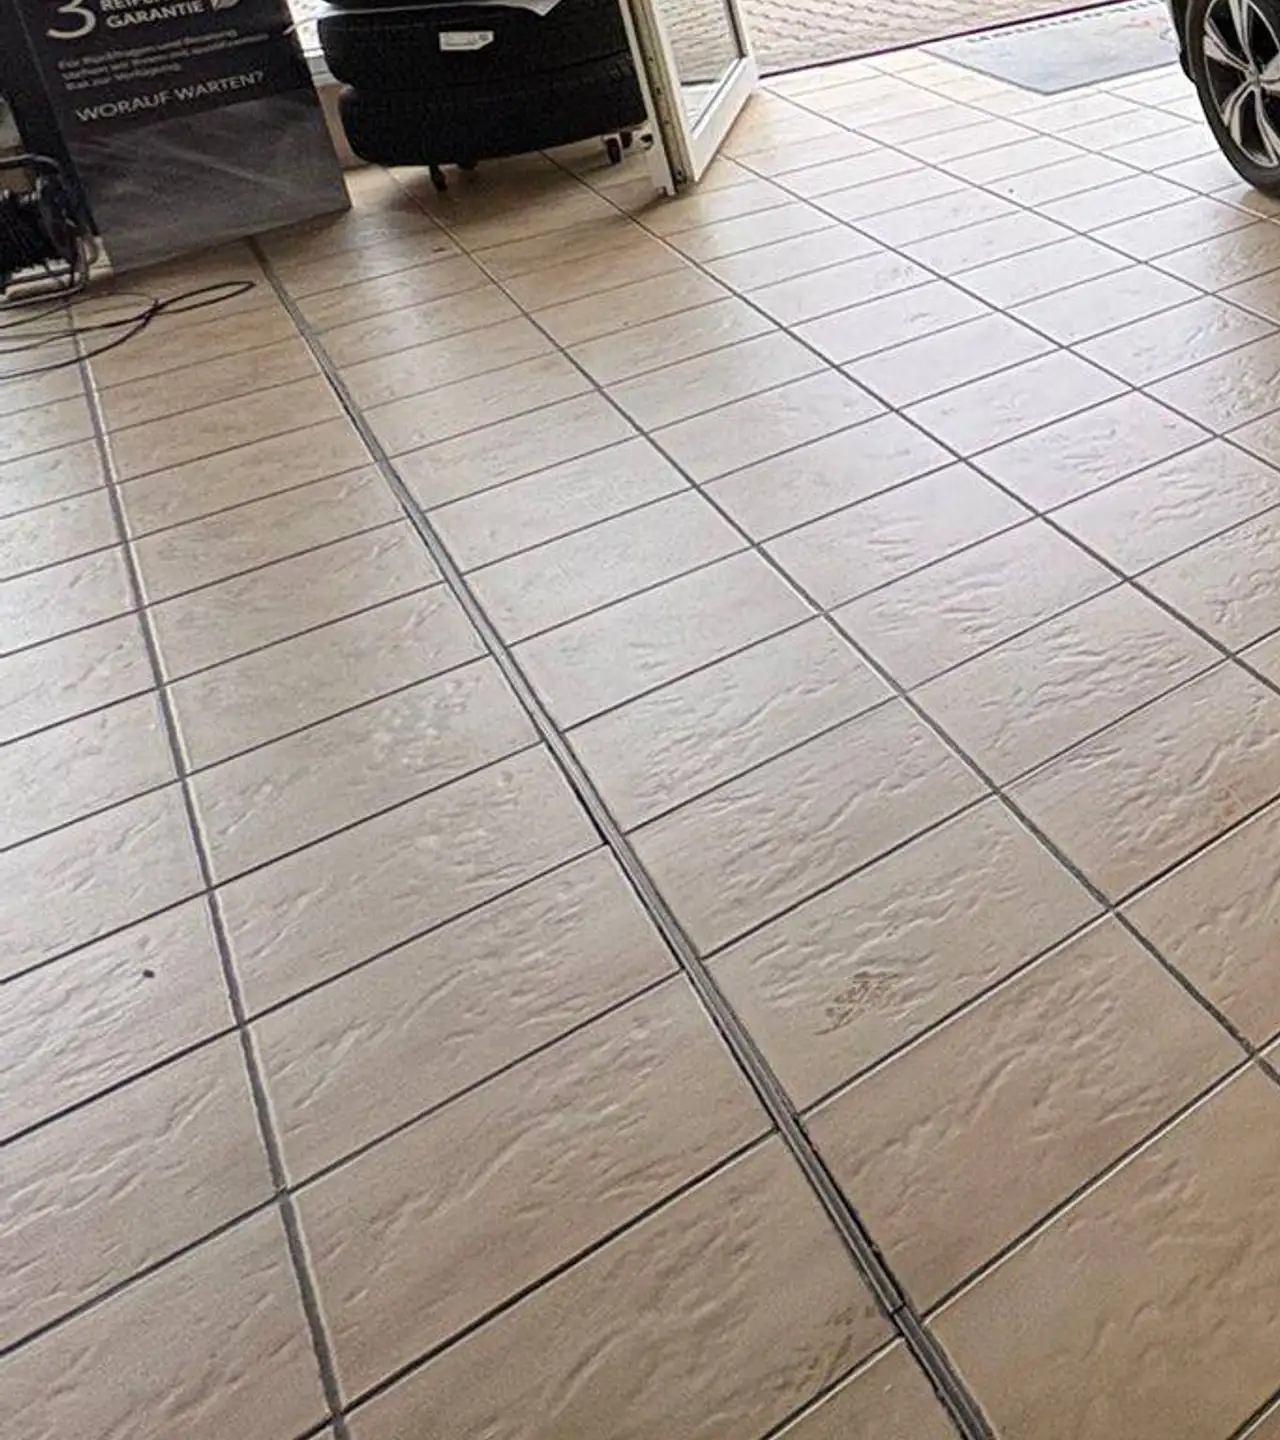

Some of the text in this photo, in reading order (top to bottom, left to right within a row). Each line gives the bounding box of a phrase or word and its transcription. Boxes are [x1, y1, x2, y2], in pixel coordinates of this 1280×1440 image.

[105, 0, 205, 29] GARANTIE
[76, 93, 174, 122] WORAUF
[173, 70, 265, 102] WARTEN?
